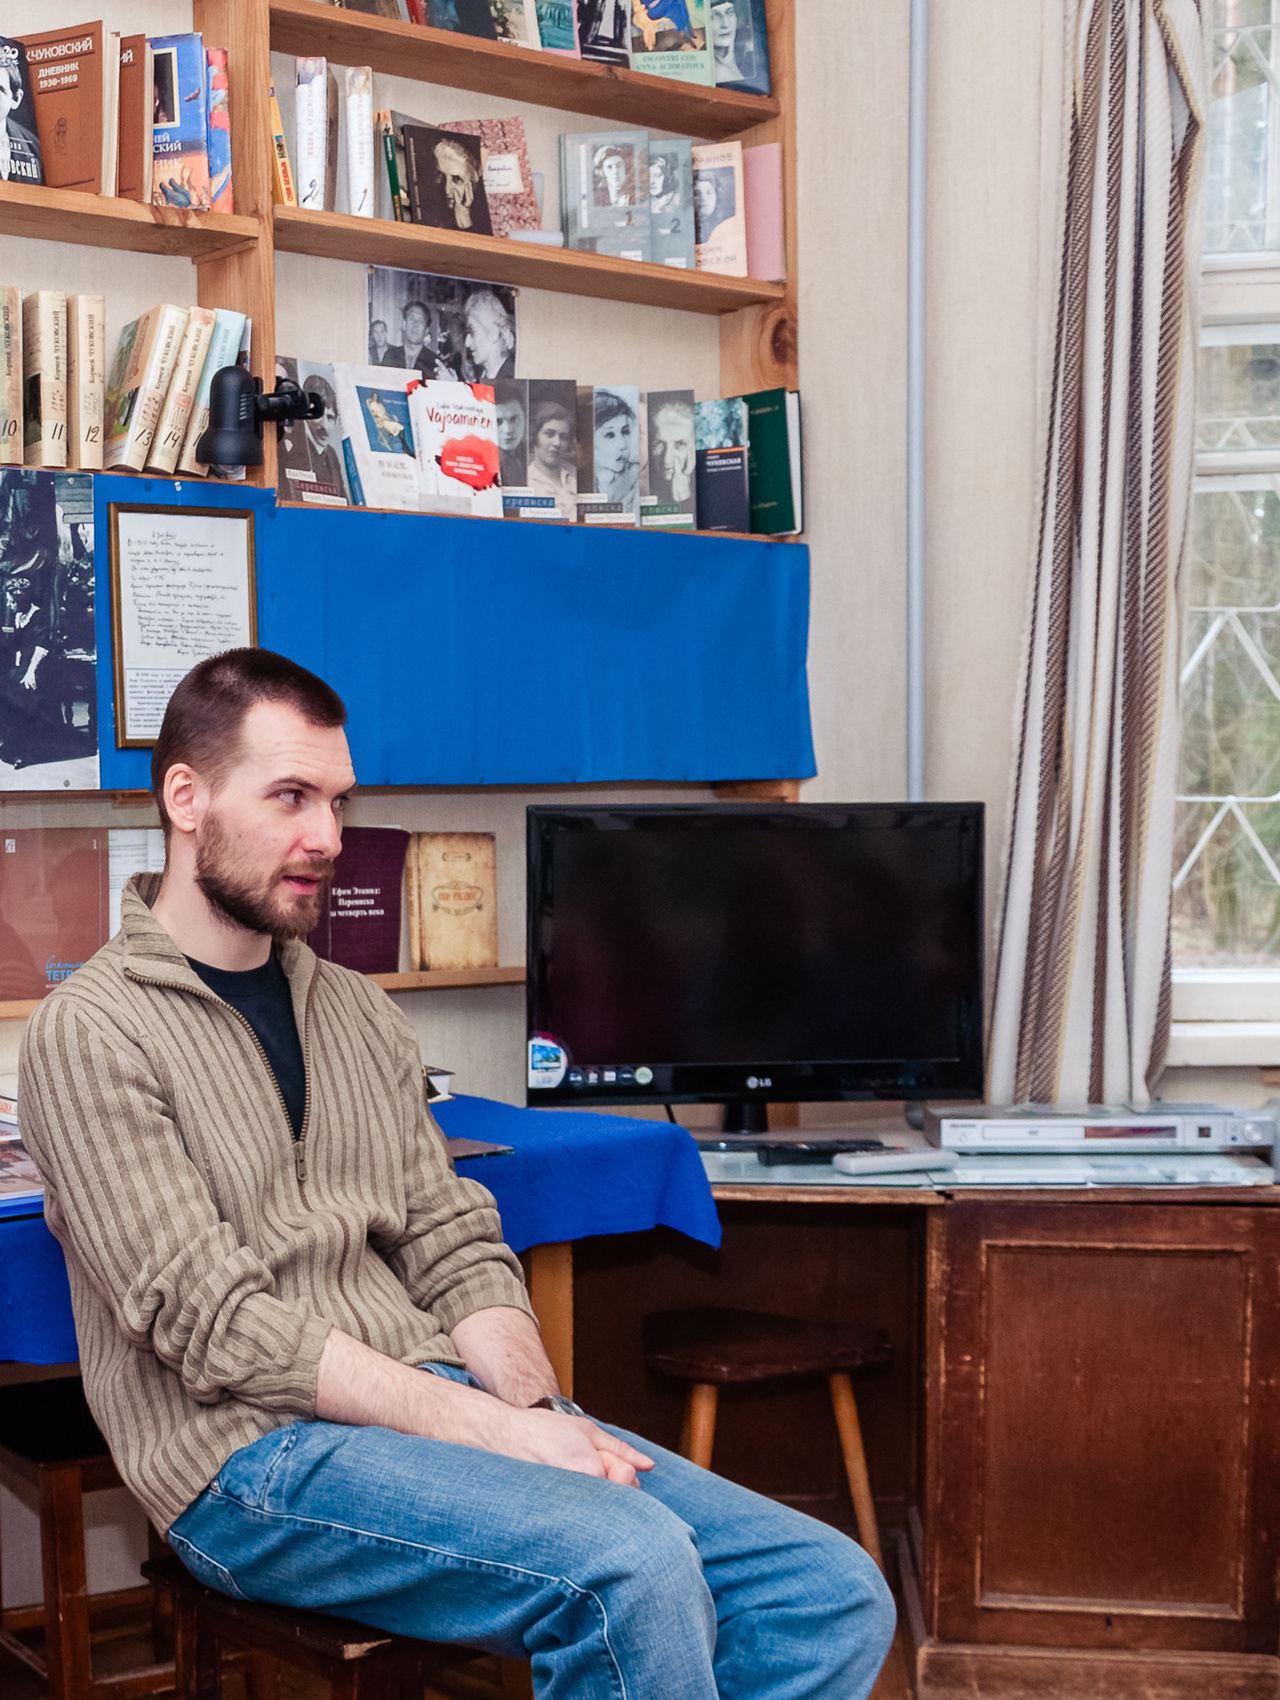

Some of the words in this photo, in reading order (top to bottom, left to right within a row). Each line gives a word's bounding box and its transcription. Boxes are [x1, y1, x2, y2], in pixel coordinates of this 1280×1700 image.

[38, 62, 80, 79] ДНЕВНИК
[671, 218, 681, 234] 2
[2, 419, 18, 437] 10
[51, 422, 65, 440] 11
[85, 425, 100, 443] 12
[135, 428, 153, 446] 13
[163, 431, 181, 448] 14
[504, 496, 556, 508] ереписка
[338, 898, 375, 908] Переписка
[46, 969, 74, 981] ТЕТР
[759, 1077, 772, 1088] LG
